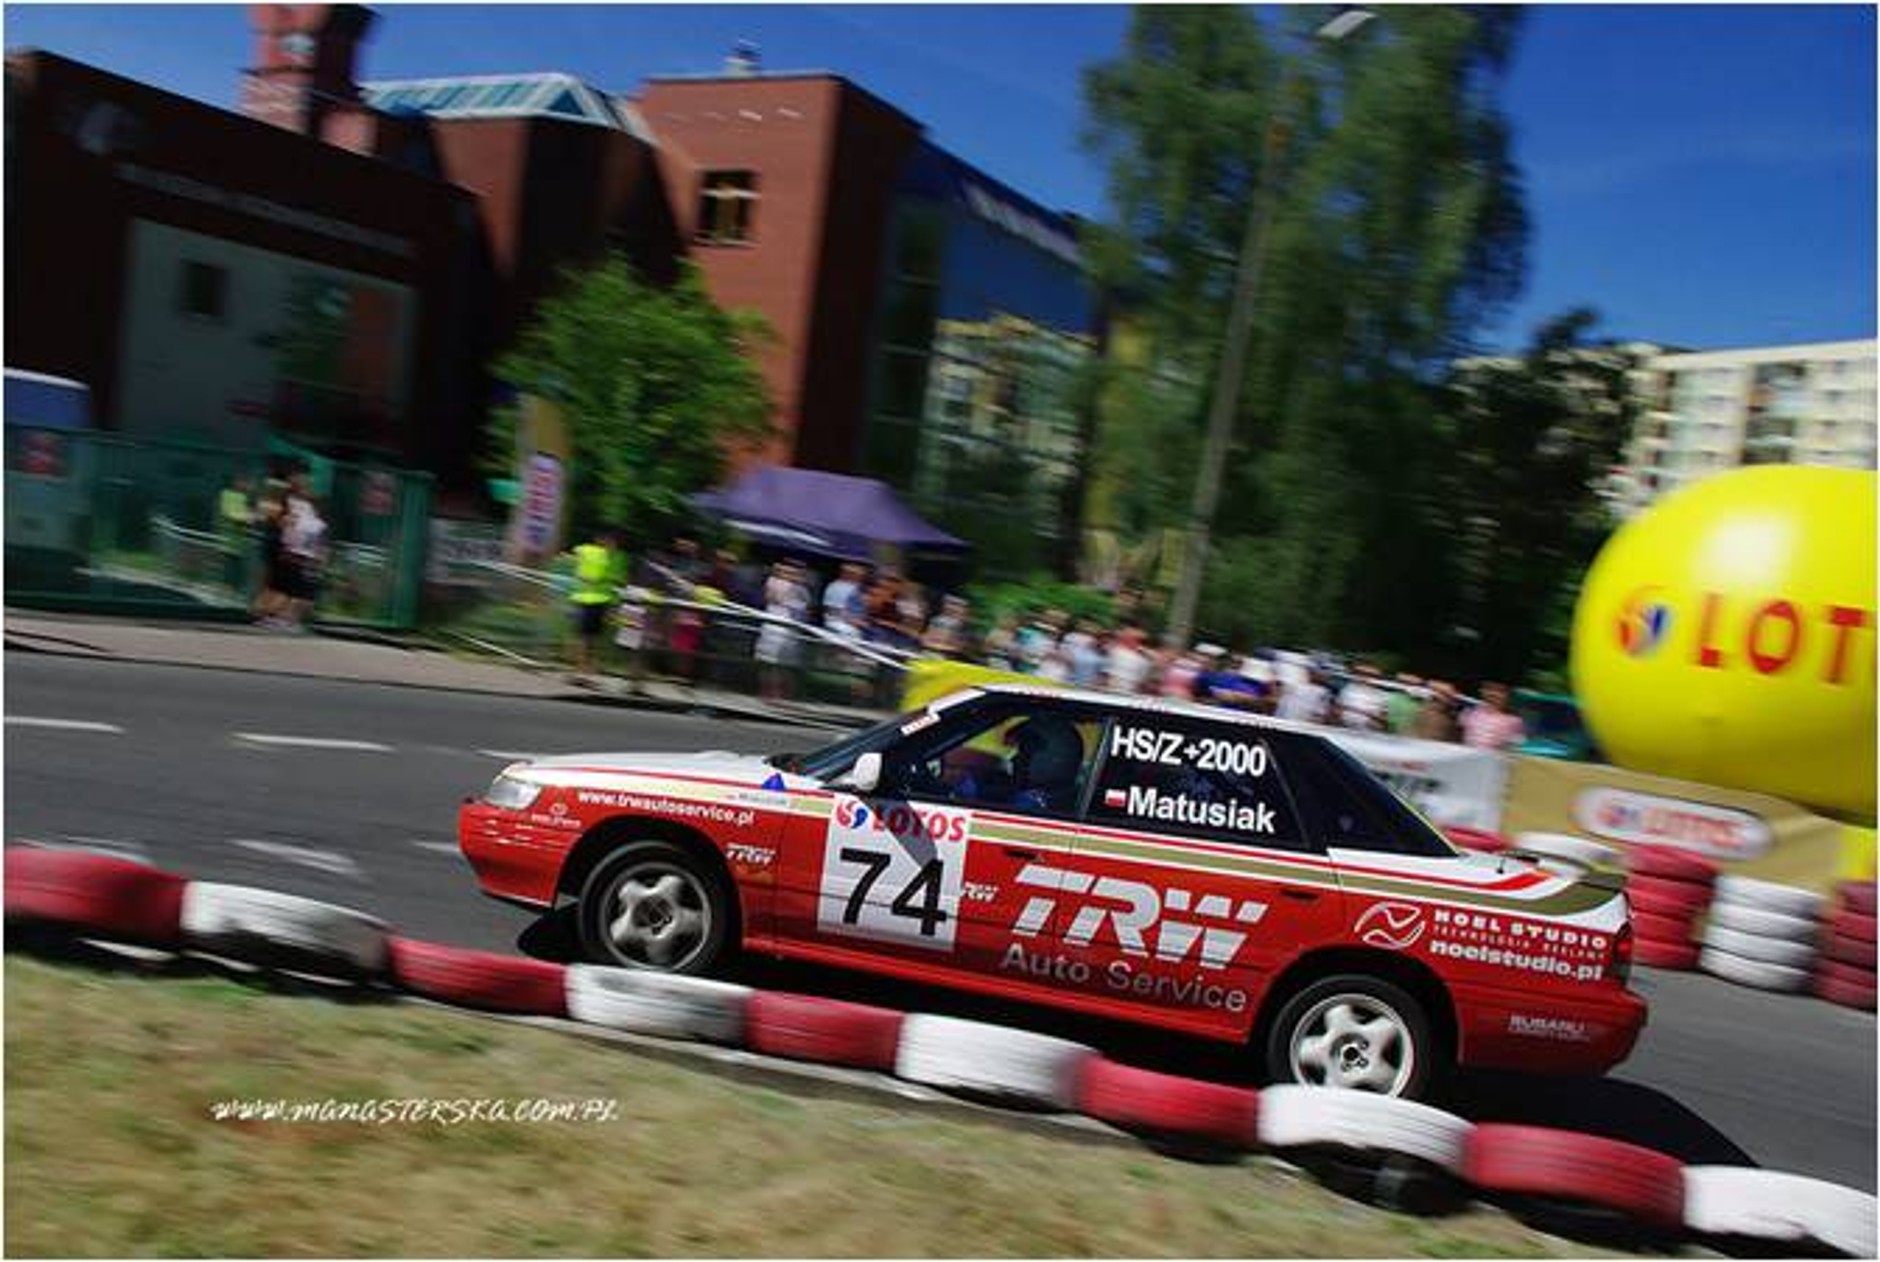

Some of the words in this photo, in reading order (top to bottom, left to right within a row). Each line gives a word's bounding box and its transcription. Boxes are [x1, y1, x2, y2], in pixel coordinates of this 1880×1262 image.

[578, 791, 755, 826] www.trwautoservice.pl
[873, 806, 967, 842] LOTOS
[1127, 785, 1276, 834] Matusiak
[840, 847, 948, 936] 74
[1011, 865, 1268, 969] TRW
[1434, 909, 1502, 933] NOEL
[1510, 922, 1608, 950] STUDIO
[1001, 942, 1091, 982] Auto
[1107, 960, 1247, 1012] Service
[1430, 940, 1603, 980] noelstudio.pl
